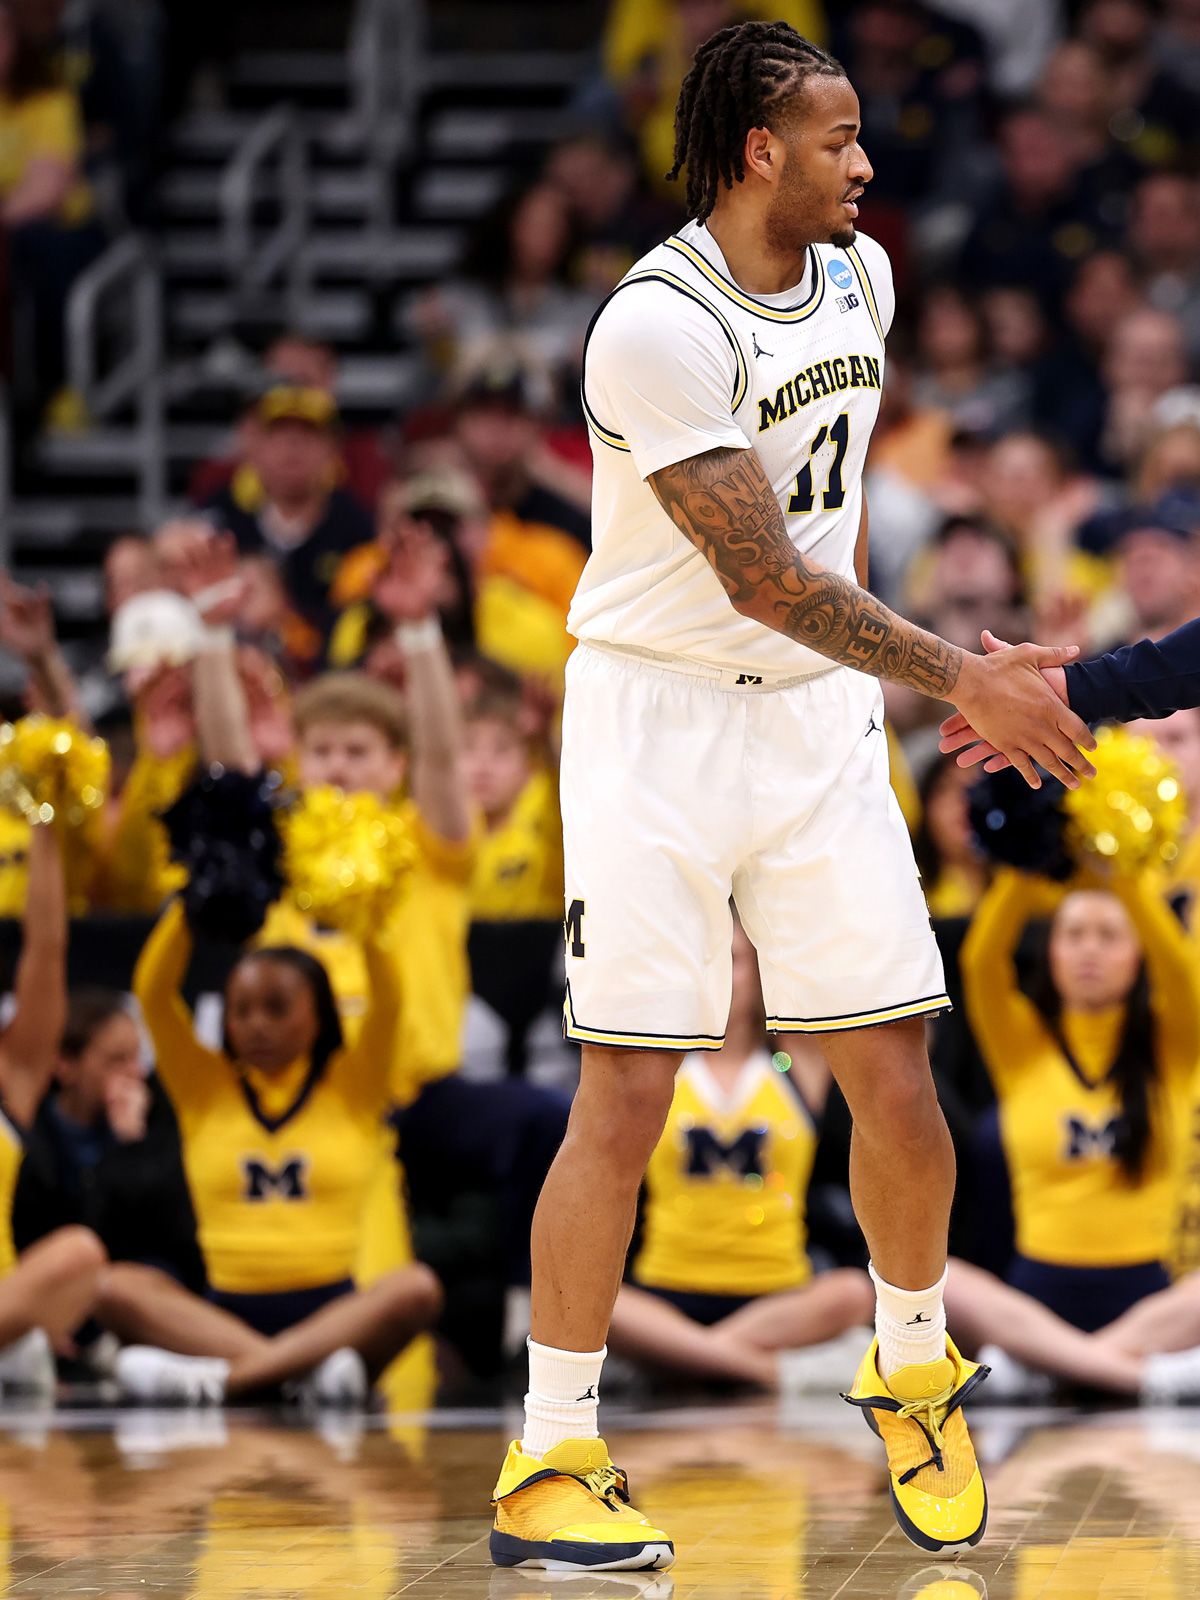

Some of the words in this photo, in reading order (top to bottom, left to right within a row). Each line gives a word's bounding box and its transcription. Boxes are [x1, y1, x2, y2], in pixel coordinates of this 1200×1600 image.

[757, 354, 881, 432] MICHIGAN
[786, 411, 849, 515] 11
[685, 1125, 766, 1179] M
[1066, 1115, 1121, 1158] M
[243, 1157, 306, 1202] M
